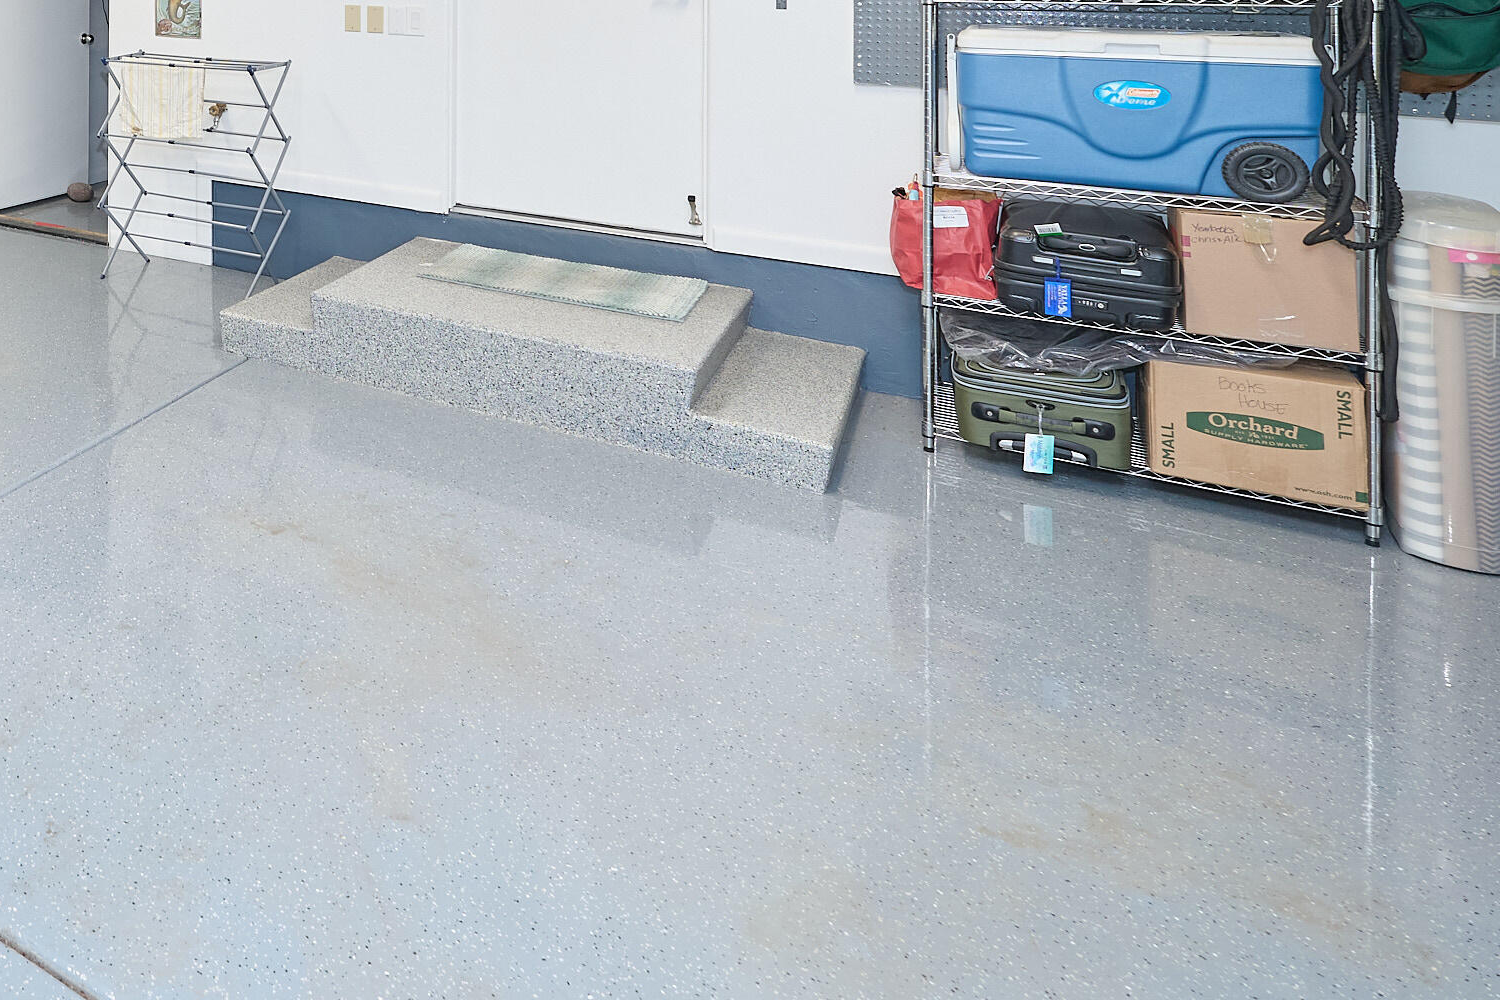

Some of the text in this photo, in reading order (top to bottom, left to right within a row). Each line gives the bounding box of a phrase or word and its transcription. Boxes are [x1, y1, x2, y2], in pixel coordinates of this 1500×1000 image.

[1207, 413, 1300, 440] Orchard
[1336, 390, 1354, 440] SMALL
[1160, 422, 1176, 469] SMALL
[1203, 428, 1244, 441] SUPPLY
